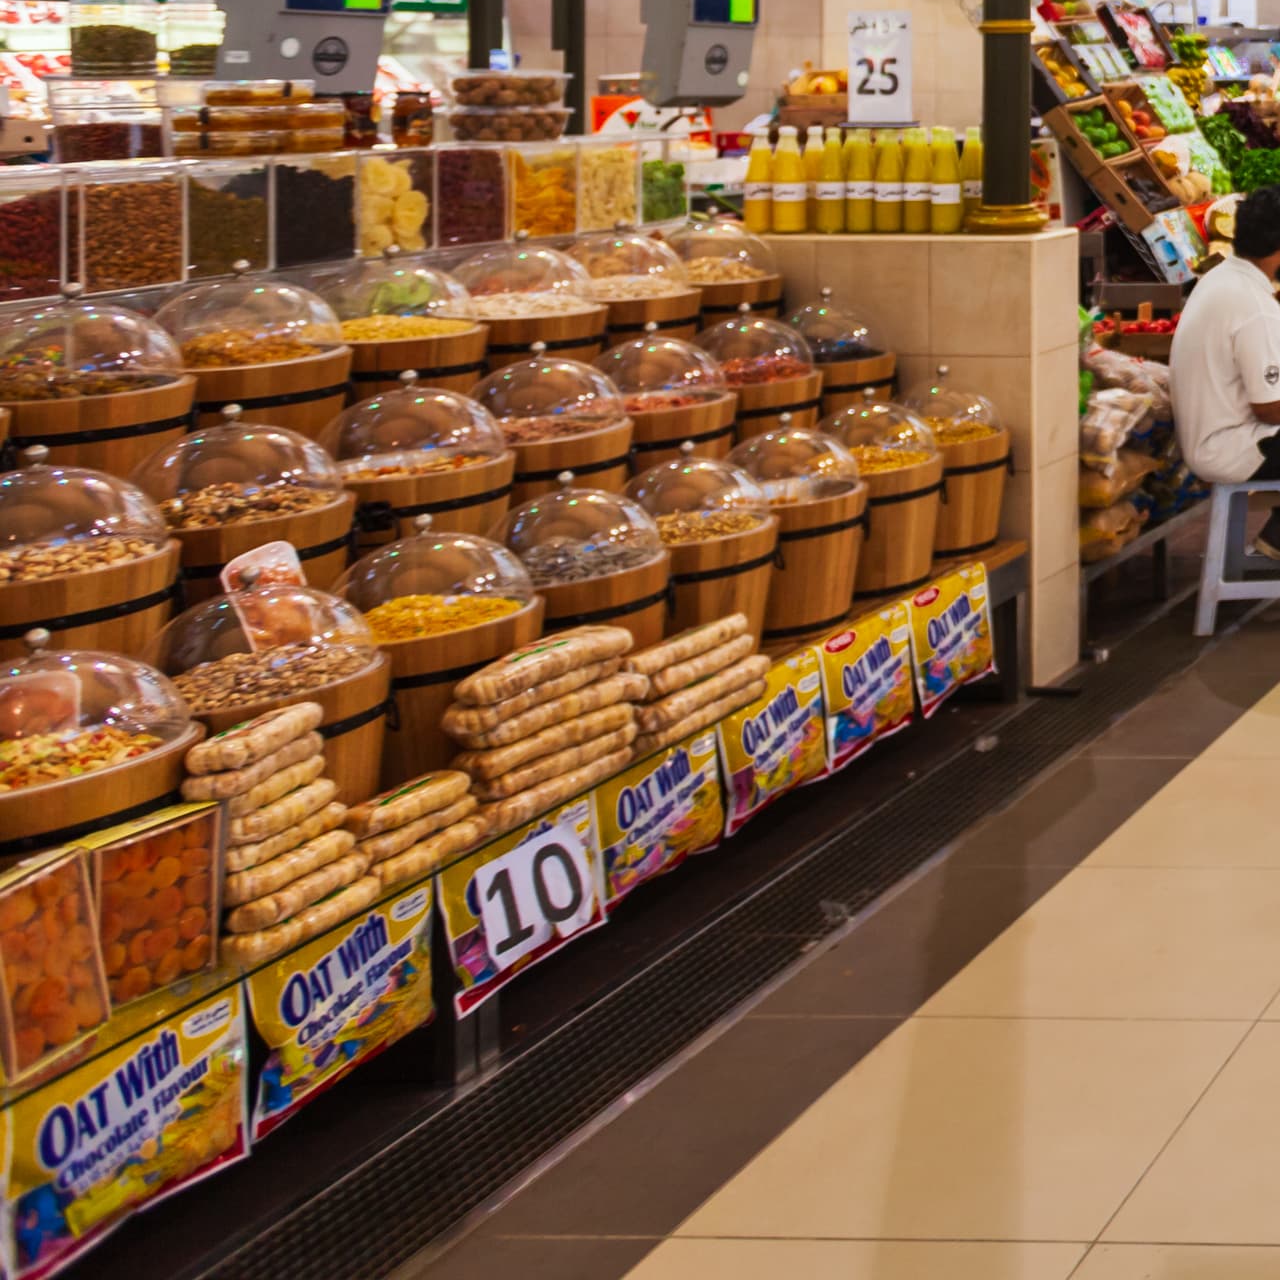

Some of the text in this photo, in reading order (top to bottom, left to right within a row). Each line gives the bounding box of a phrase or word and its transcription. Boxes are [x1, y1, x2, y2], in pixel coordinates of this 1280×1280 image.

[856, 57, 899, 96] 25
[742, 706, 771, 756] OAT
[617, 778, 656, 830] OAT
[486, 842, 584, 957] 10
[281, 957, 333, 1027] OAT
[339, 913, 389, 979] With
[298, 937, 414, 1047] Chocolate Flavour
[39, 1092, 110, 1169] OAT
[115, 1029, 181, 1109] With
[57, 1104, 150, 1191] Chocolate
[152, 1056, 210, 1120] Flavour
